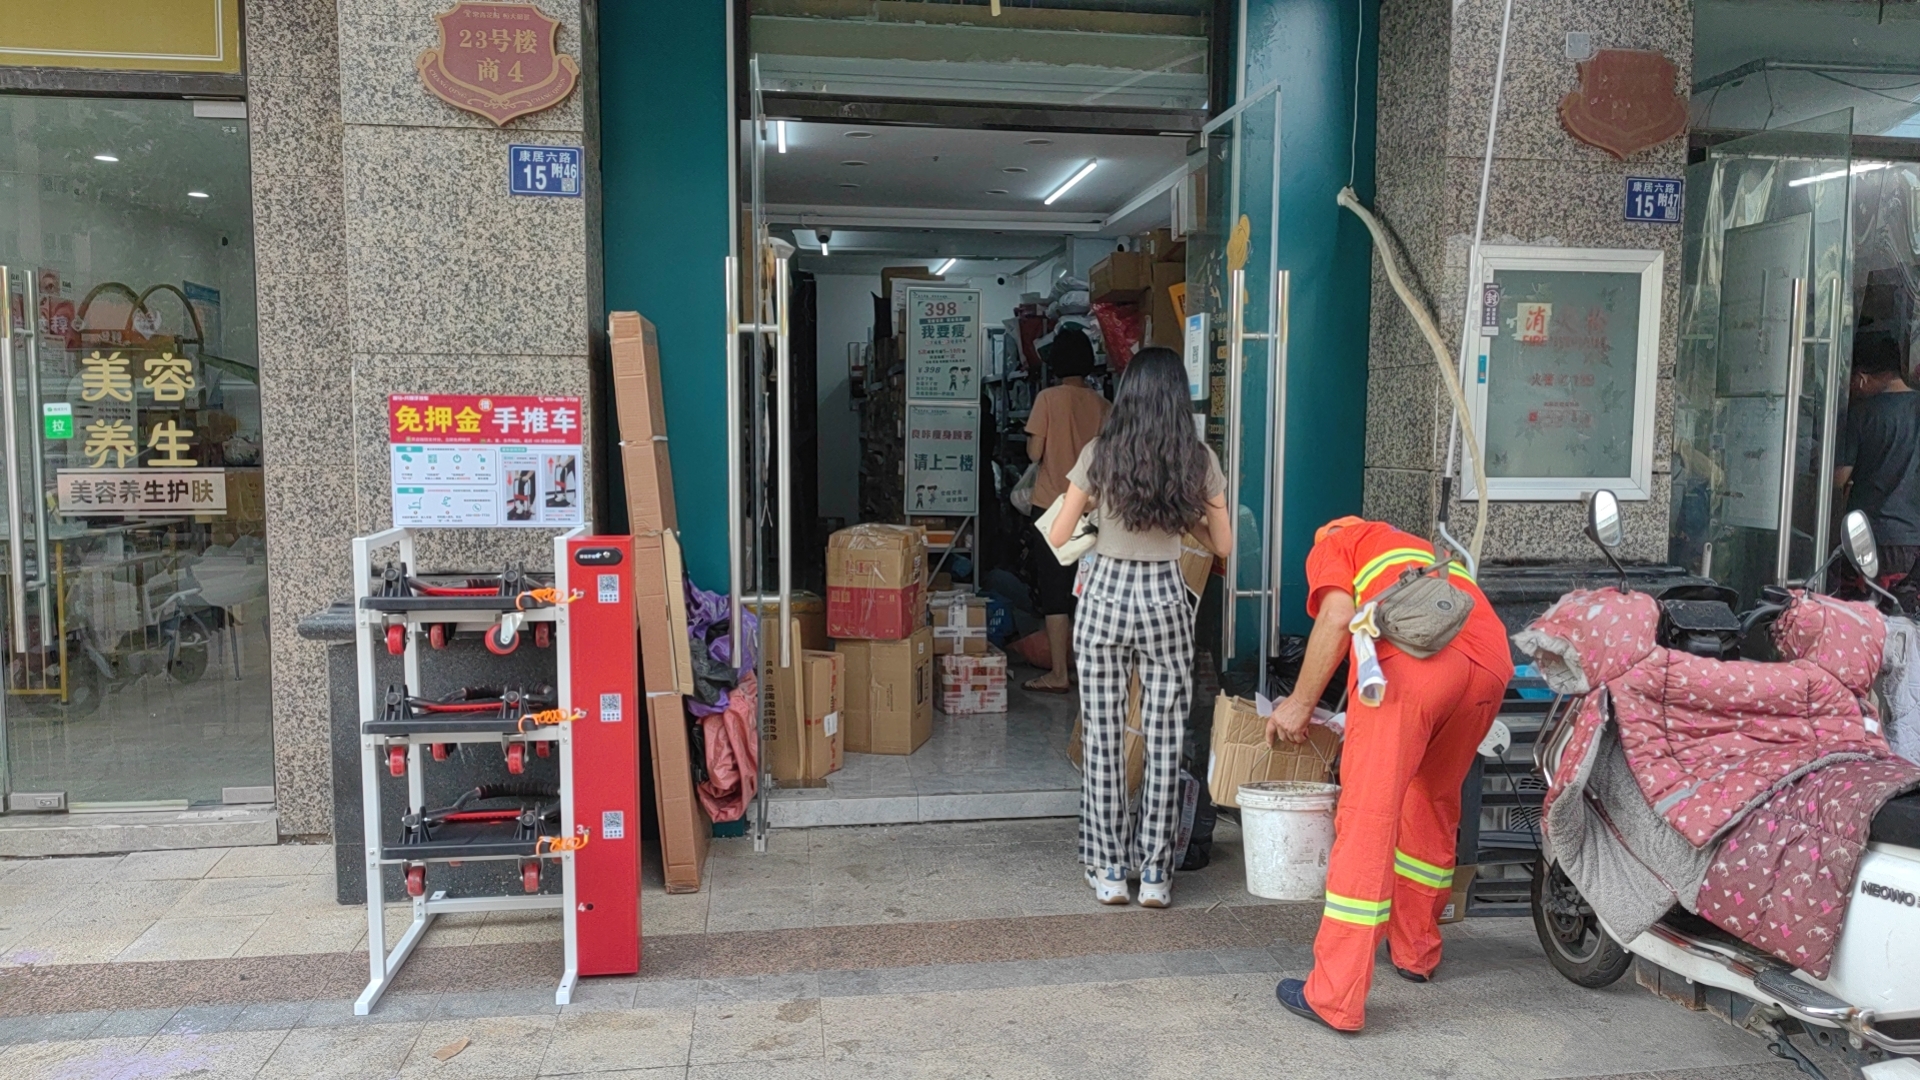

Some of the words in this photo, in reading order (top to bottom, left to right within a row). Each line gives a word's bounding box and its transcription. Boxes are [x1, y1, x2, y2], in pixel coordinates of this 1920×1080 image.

[459, 28, 538, 54] 23号楼
[519, 150, 571, 164] 康居六路
[523, 164, 547, 190] 15
[551, 163, 577, 179] 附46
[1632, 181, 1675, 194] 康居六路
[1635, 194, 1654, 217] 15
[1658, 193, 1679, 208] 附47
[924, 301, 957, 317] 398
[921, 324, 965, 339] 我要瘦
[81, 350, 195, 402] 美容
[52, 419, 65, 432] 拉
[395, 405, 482, 434] 免押金
[492, 406, 577, 434] 手推车
[84, 419, 198, 469] 养生
[914, 453, 974, 472] 请上二楼
[70, 479, 214, 504] 美容养生护肤
[576, 824, 584, 835] 3
[578, 902, 586, 912] 4
